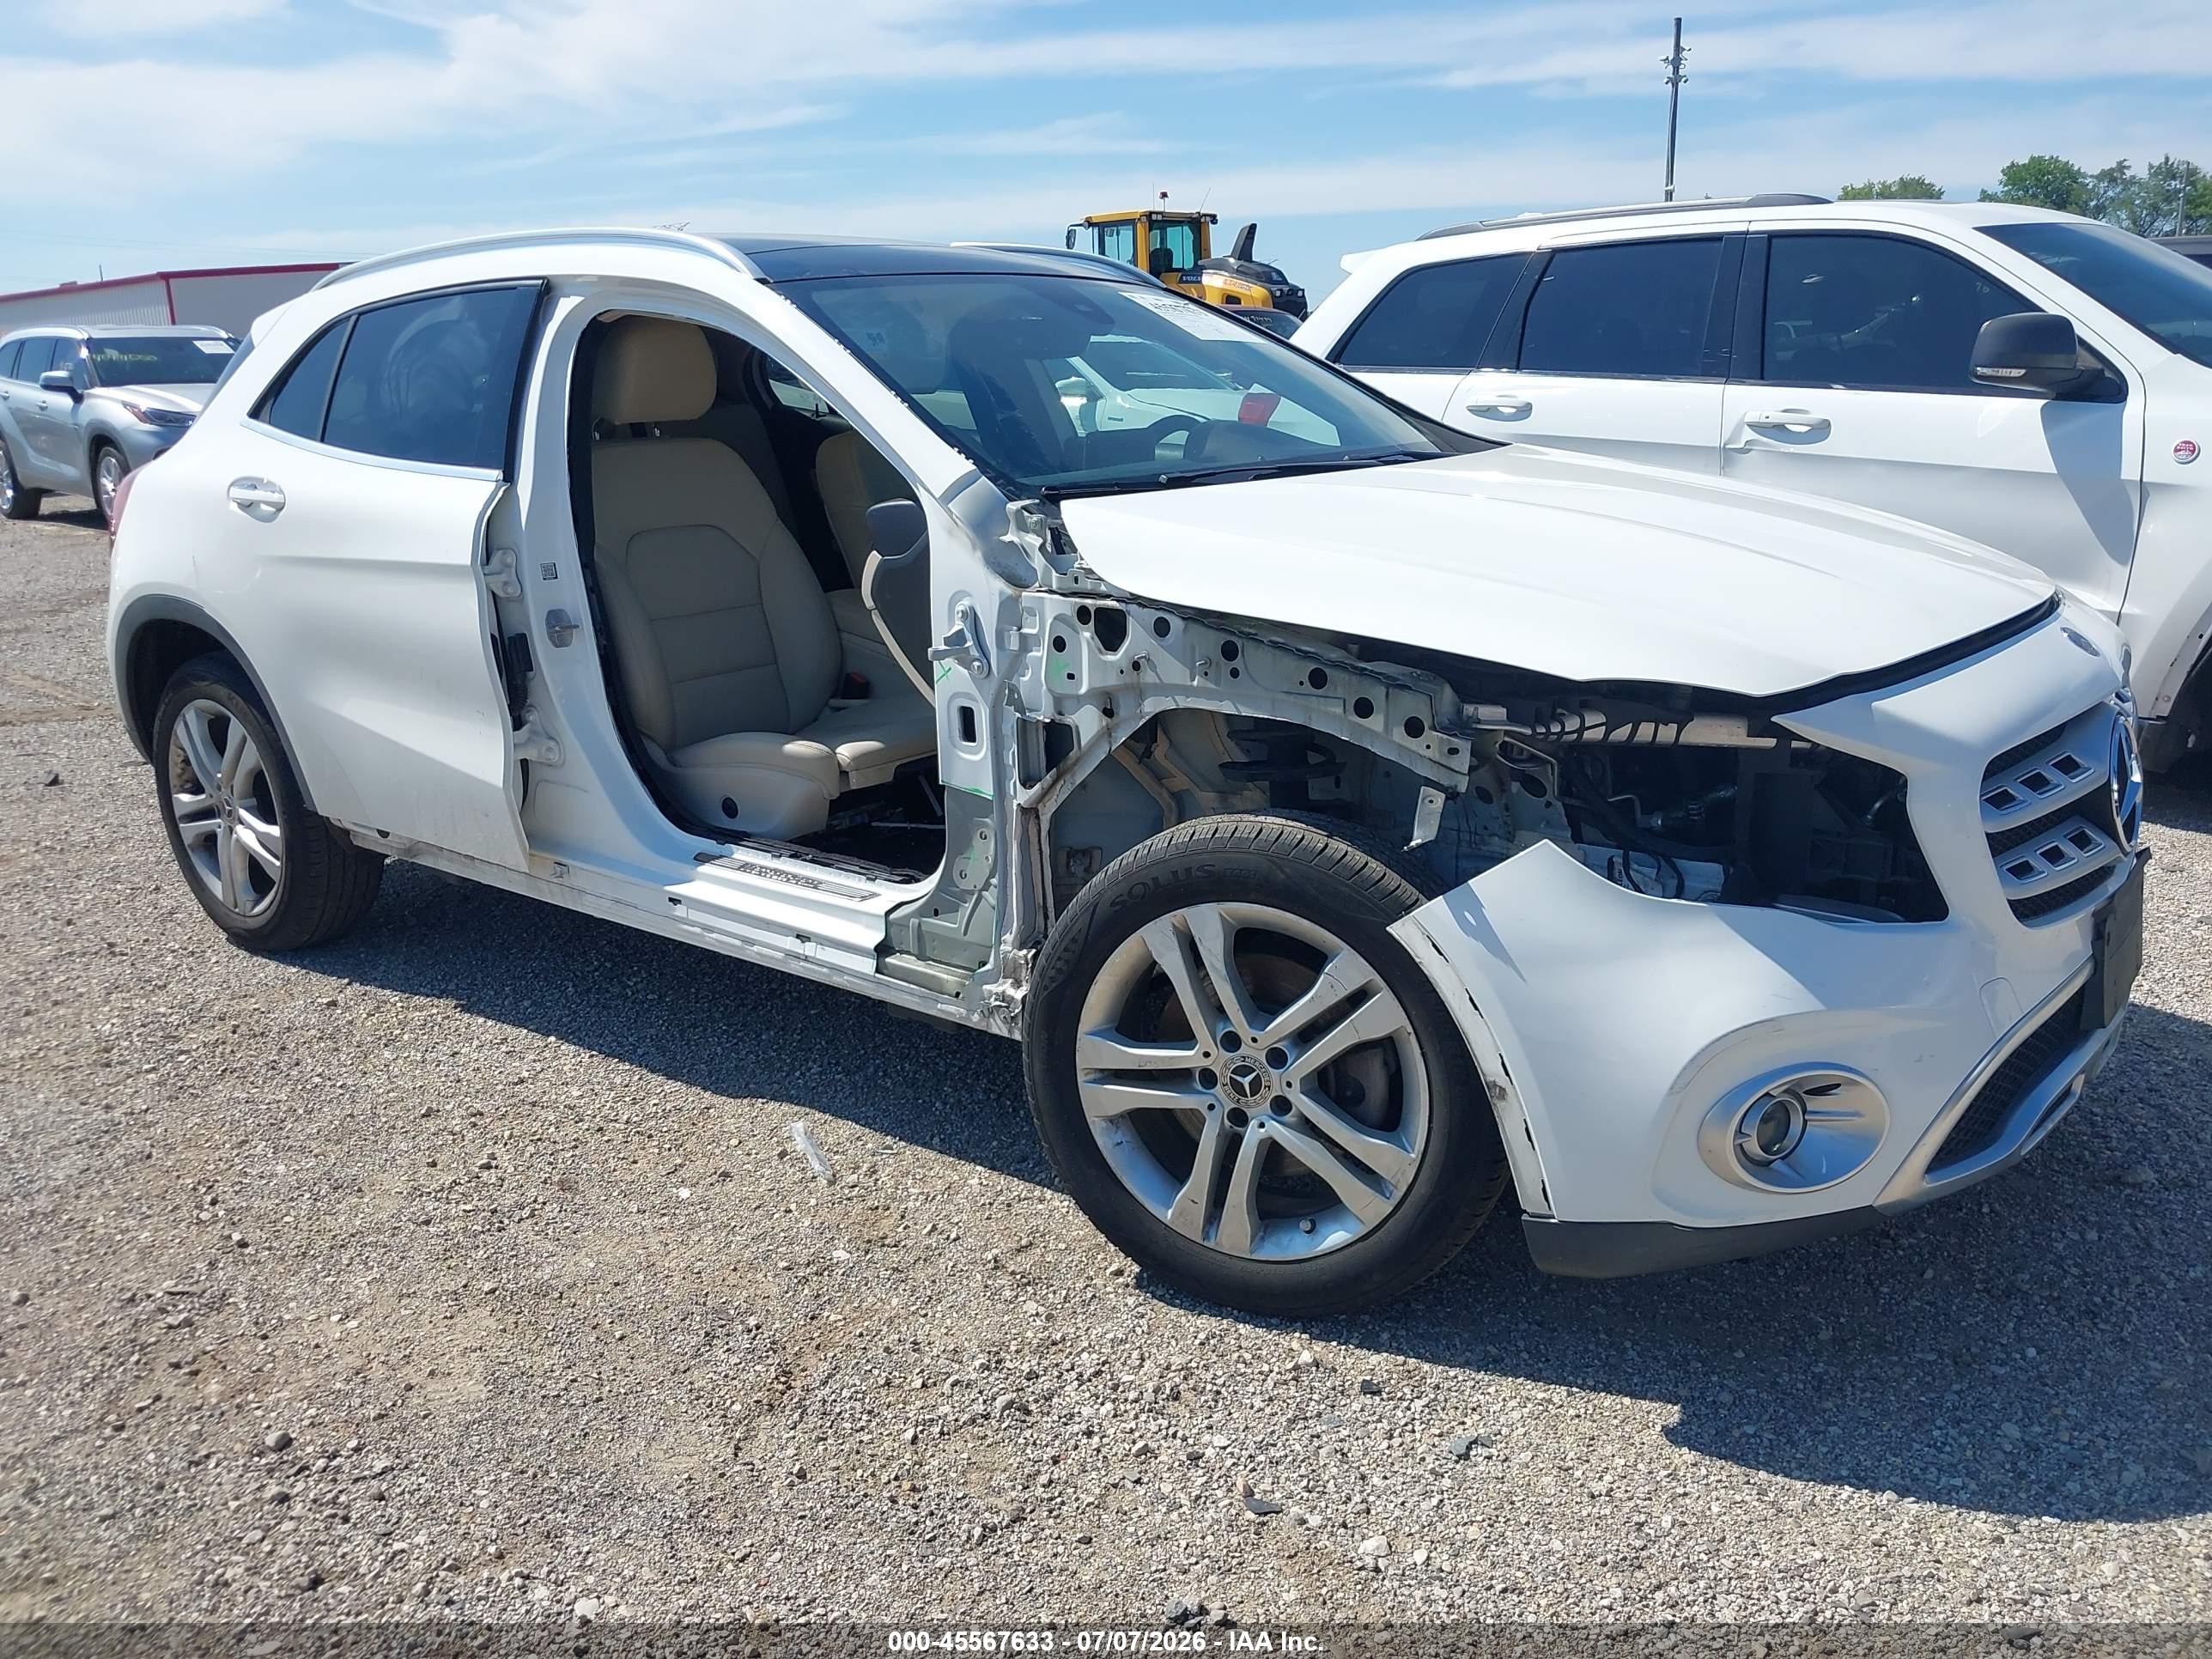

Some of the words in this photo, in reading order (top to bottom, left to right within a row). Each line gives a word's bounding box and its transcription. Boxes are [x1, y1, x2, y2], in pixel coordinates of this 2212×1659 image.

[1109, 863, 1217, 911] SOLUS
[1245, 1056, 1271, 1086] MERCEDES
[1223, 1085, 1239, 1103] BENZ
